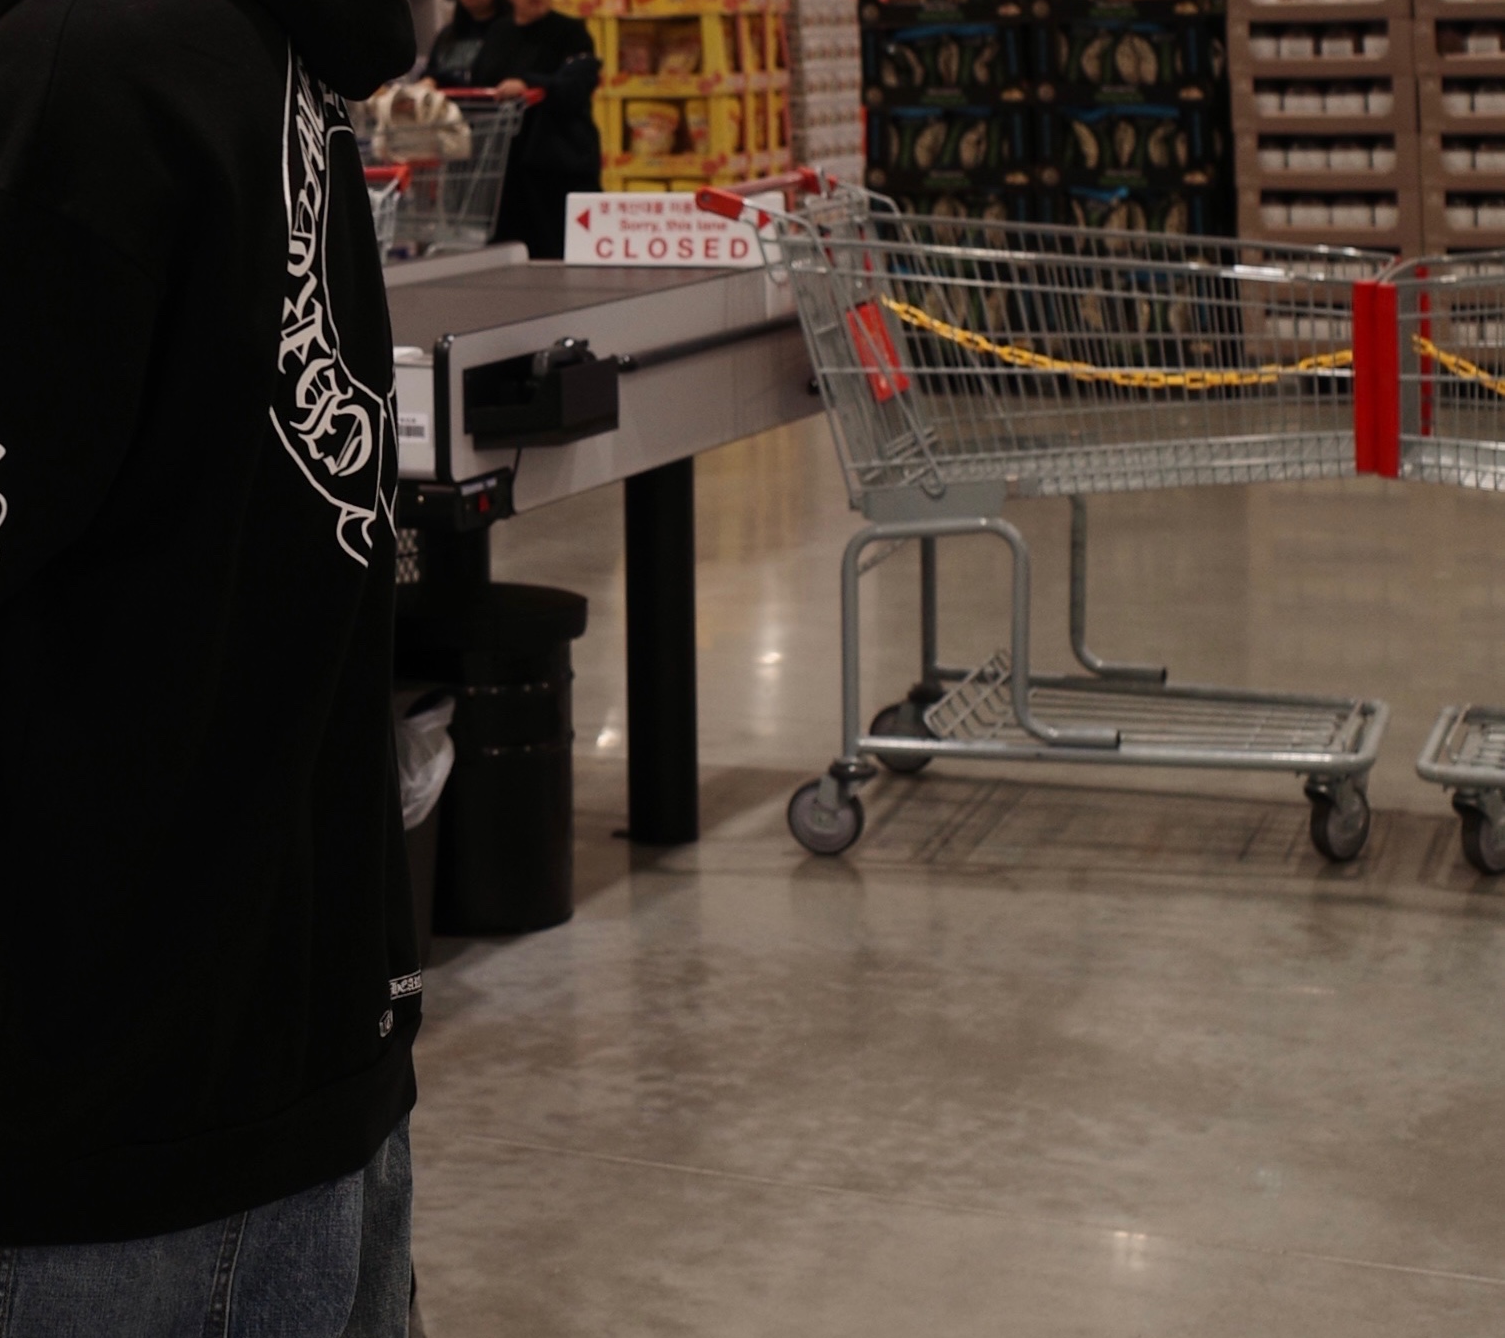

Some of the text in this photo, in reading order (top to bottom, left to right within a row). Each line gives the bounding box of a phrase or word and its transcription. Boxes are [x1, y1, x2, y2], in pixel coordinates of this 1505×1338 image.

[619, 219, 728, 232] Sorry, this lane
[595, 236, 749, 259] CLOSED
